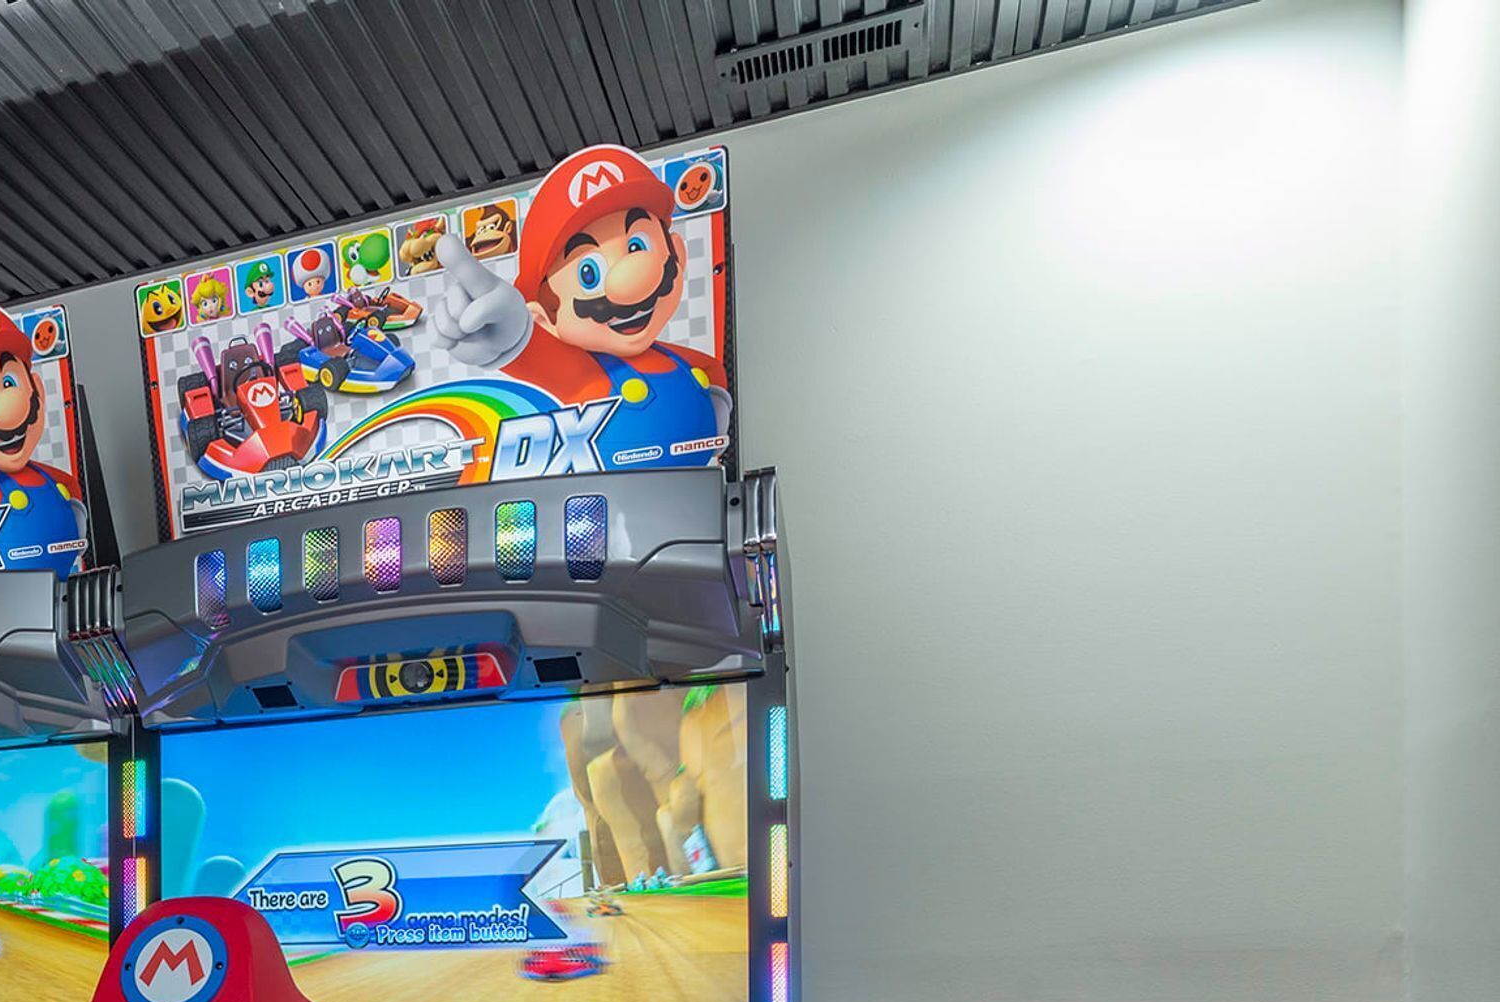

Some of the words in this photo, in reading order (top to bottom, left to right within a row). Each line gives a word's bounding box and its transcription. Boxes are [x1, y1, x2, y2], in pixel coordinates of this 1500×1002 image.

[492, 398, 620, 481] DX
[673, 437, 725, 453] namco
[616, 449, 659, 462] Nintendo
[253, 489, 360, 517] ARCADE
[376, 479, 411, 495] GP
[49, 540, 85, 552] namco
[250, 889, 295, 909] There
[299, 892, 327, 908] are
[334, 858, 400, 933] 3
[462, 905, 529, 926] modes!
[376, 924, 423, 943] Press
[427, 923, 465, 943] item
[469, 924, 527, 943] button
